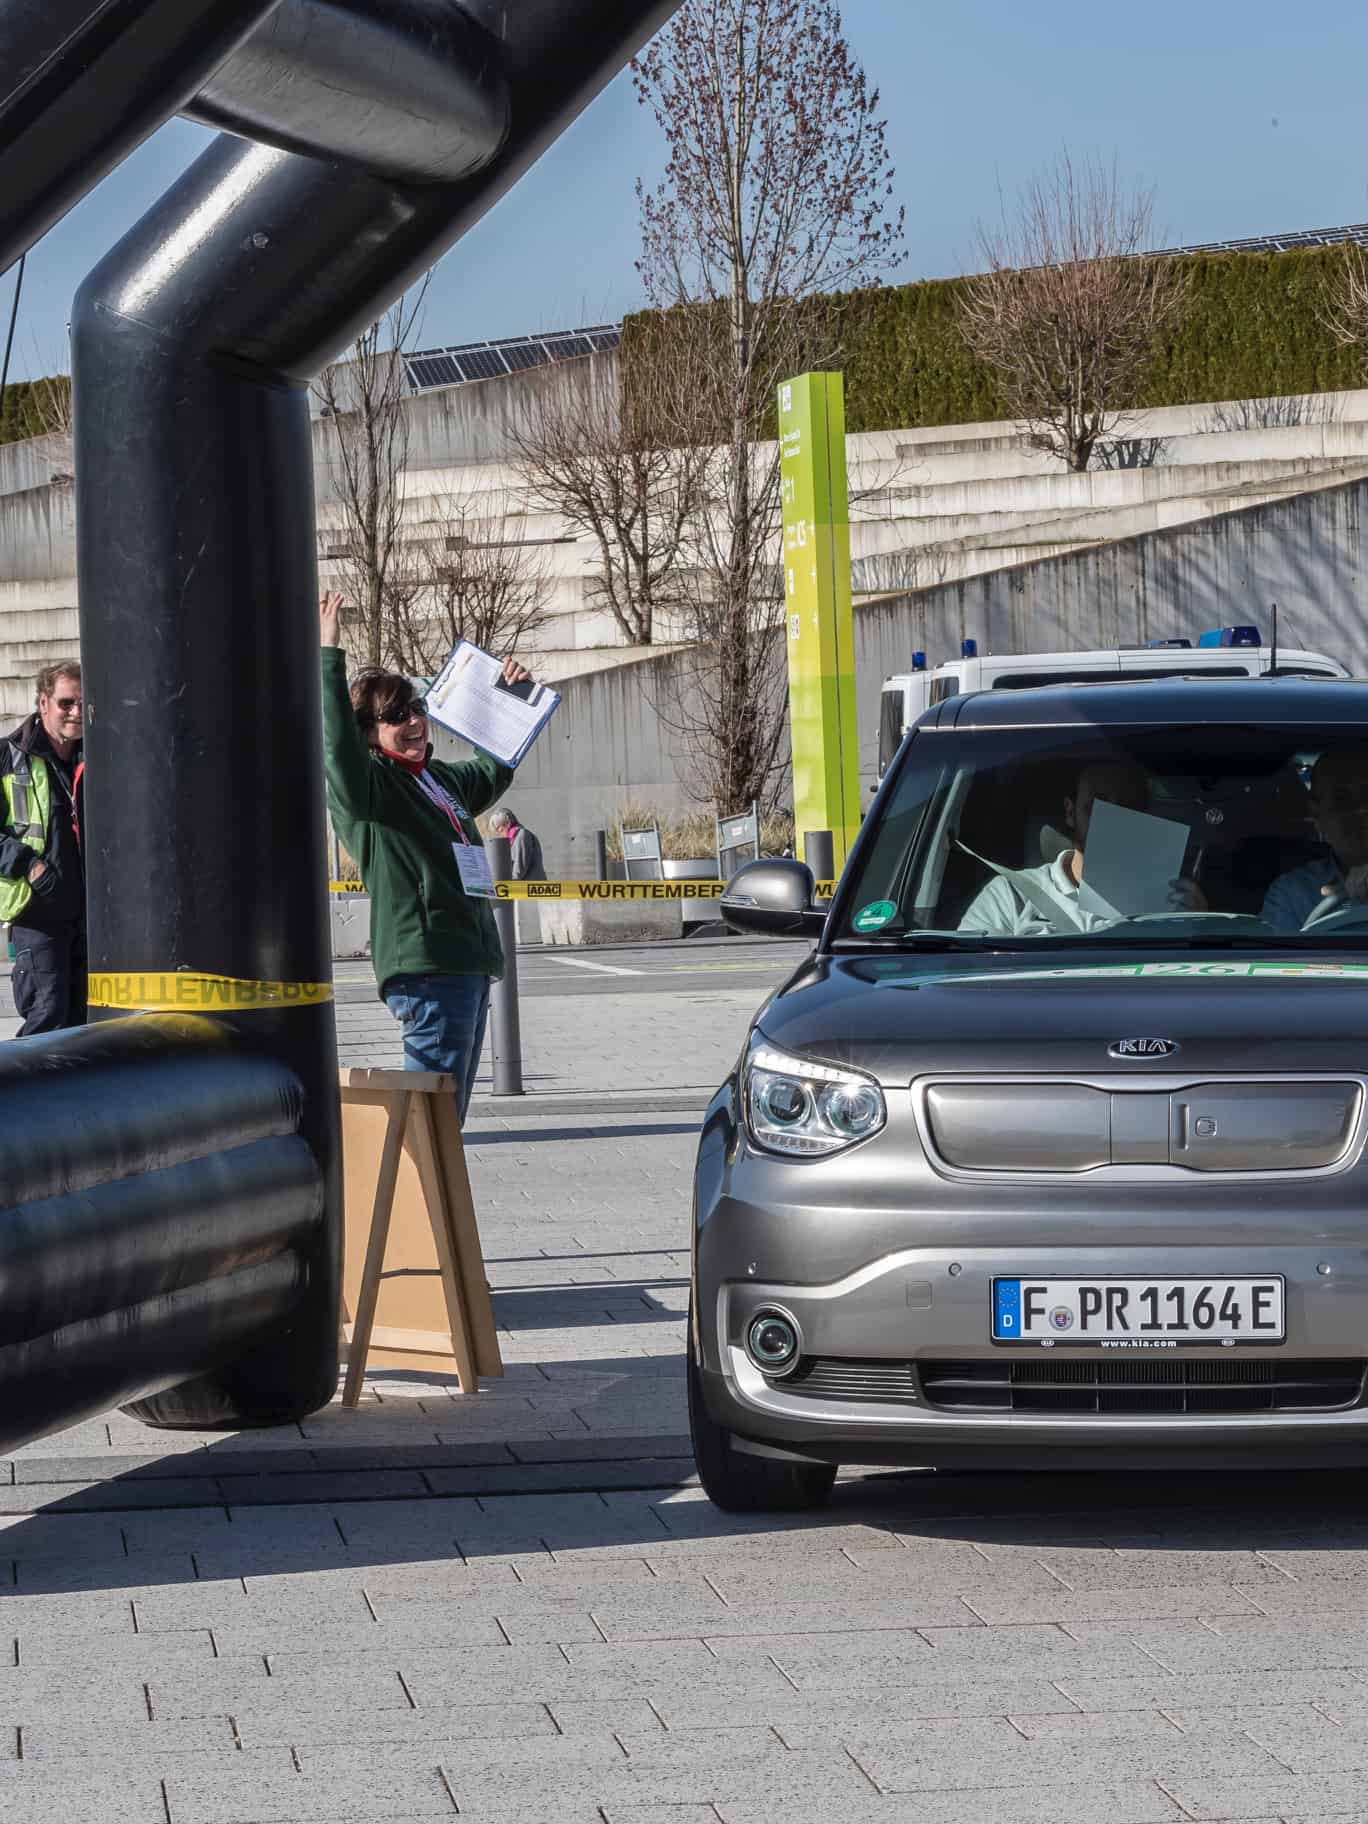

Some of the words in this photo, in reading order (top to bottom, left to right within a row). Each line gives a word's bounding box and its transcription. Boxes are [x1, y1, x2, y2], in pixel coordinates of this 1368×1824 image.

[529, 884, 560, 896] ADAC
[1119, 1039, 1168, 1053] KIA
[1003, 1314, 1014, 1328] D
[1101, 1340, 1177, 1348] www.kia.com
